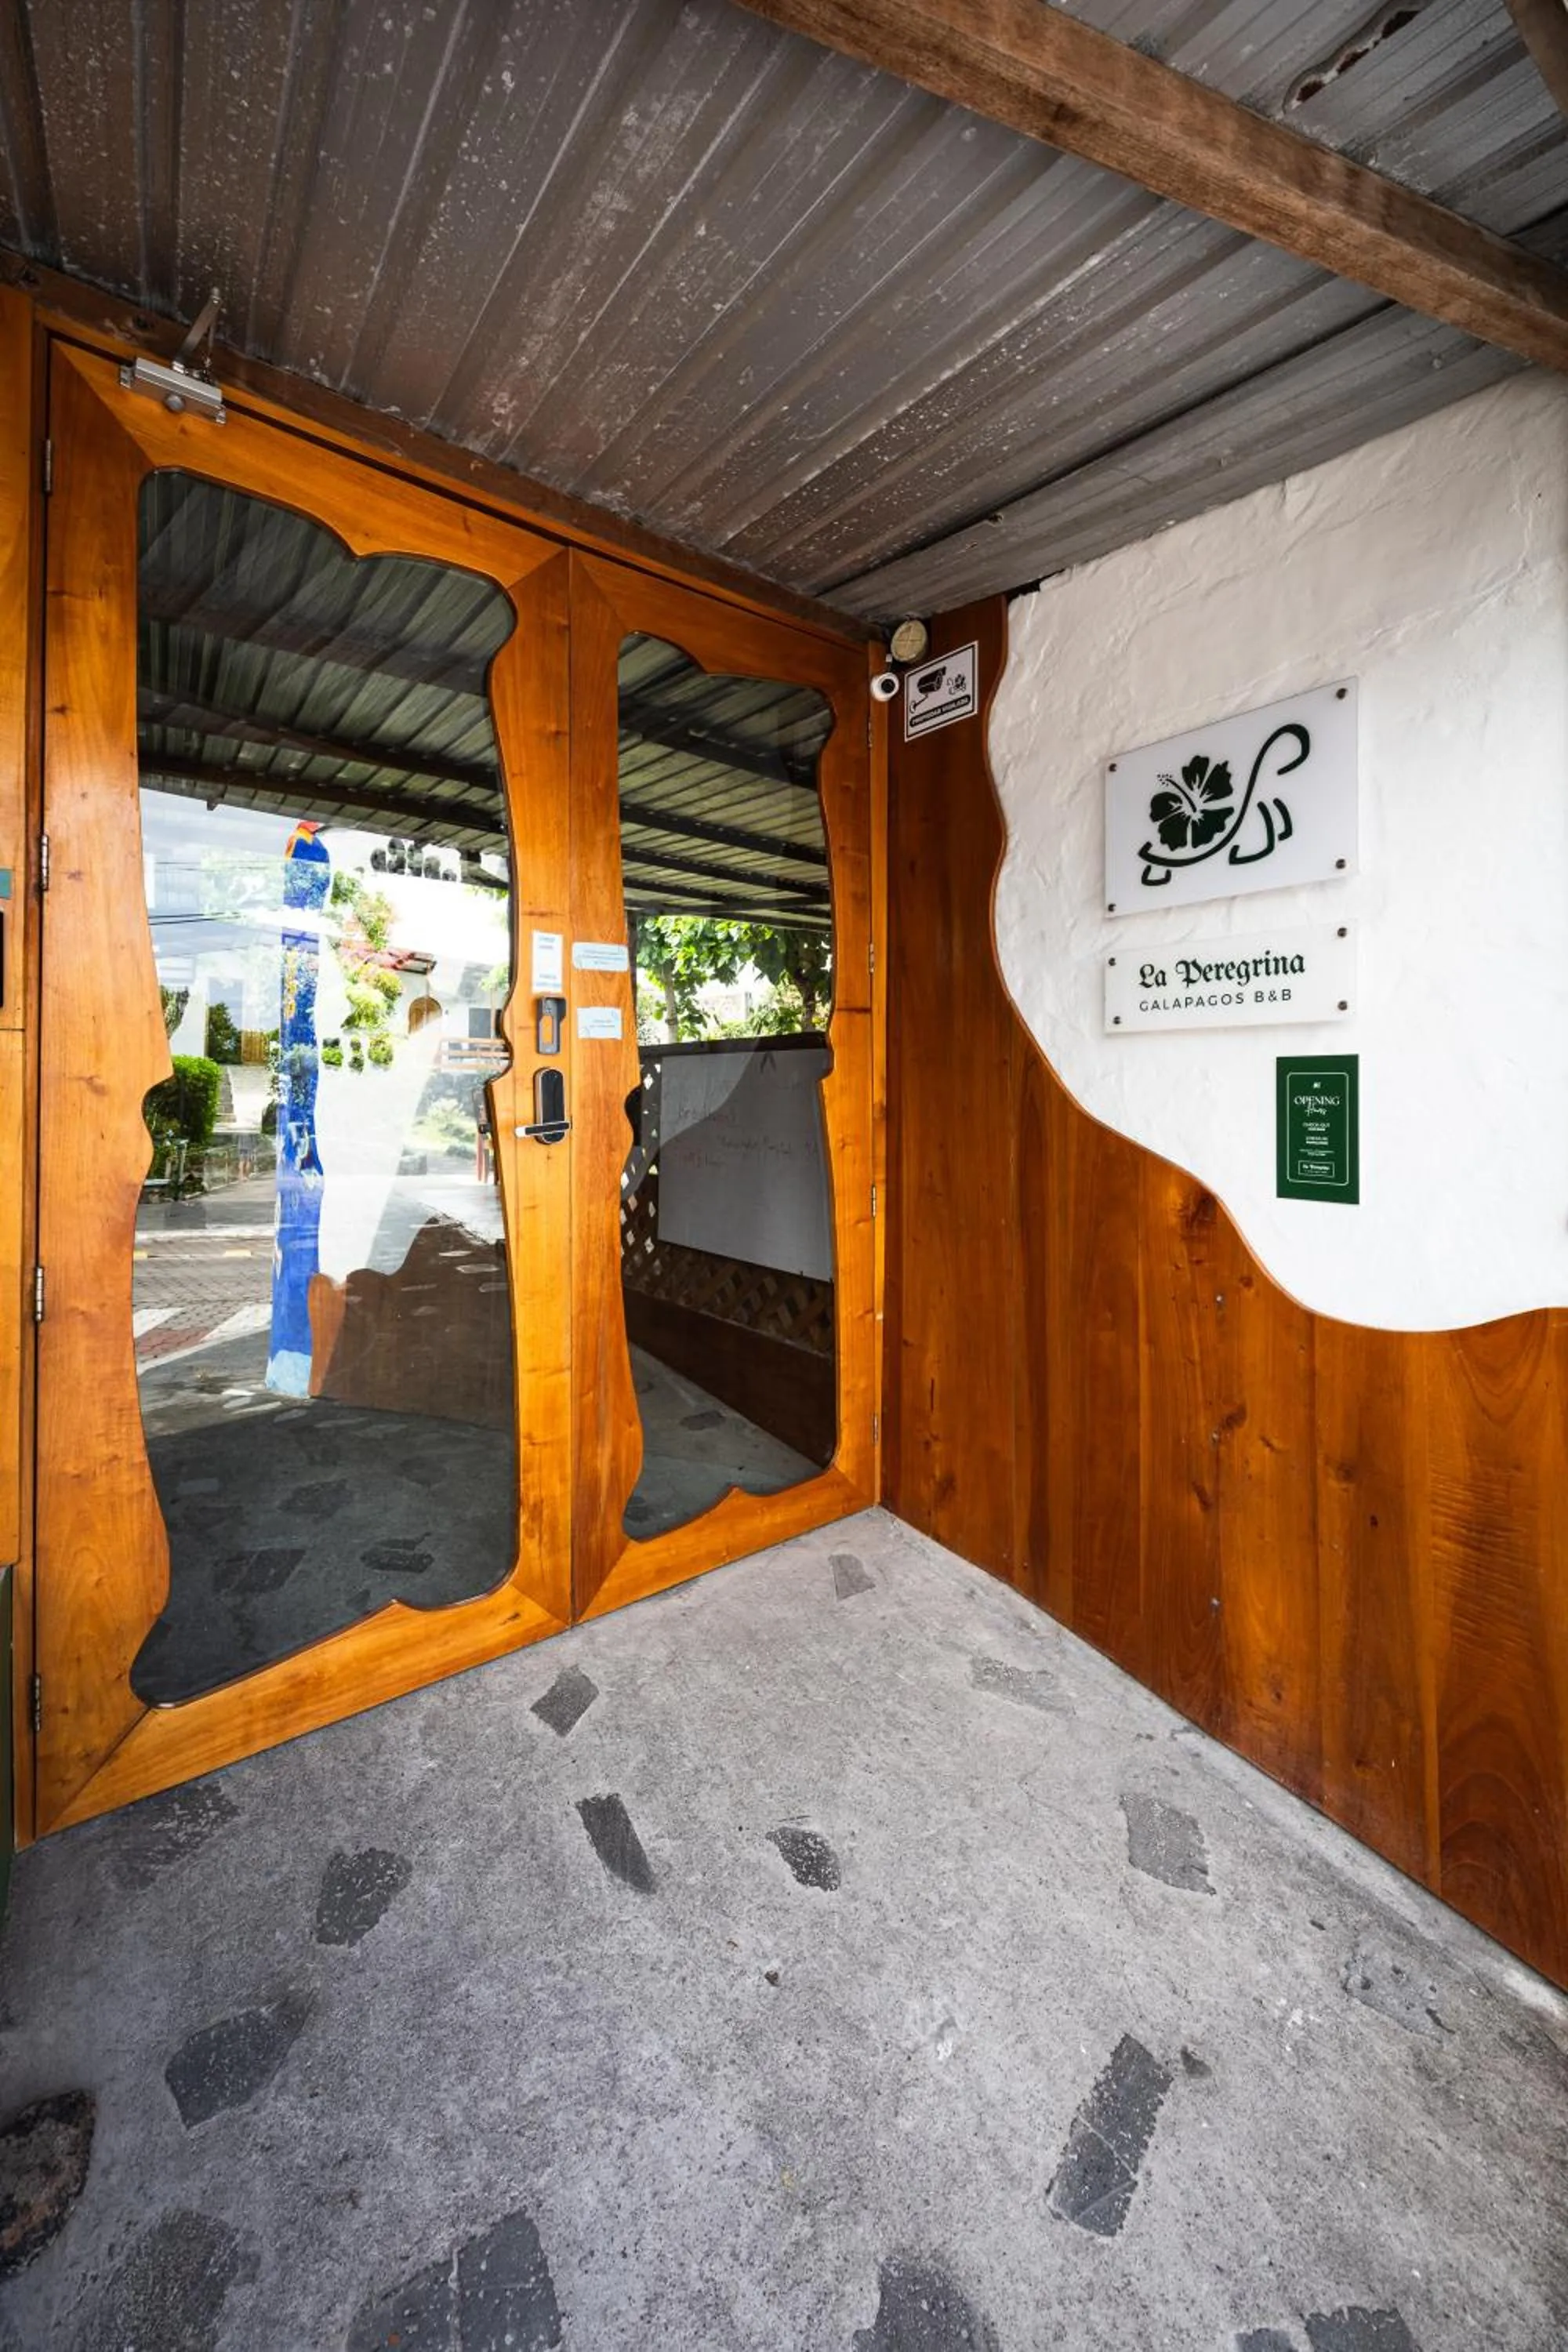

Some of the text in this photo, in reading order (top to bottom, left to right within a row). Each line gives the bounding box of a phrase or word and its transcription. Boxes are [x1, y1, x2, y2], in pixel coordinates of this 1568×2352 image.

[1138, 949, 1306, 989] La Peregrina
[1139, 989, 1292, 1012] GALAPAGOS B&B
[1294, 1096, 1340, 1106] OPENING
